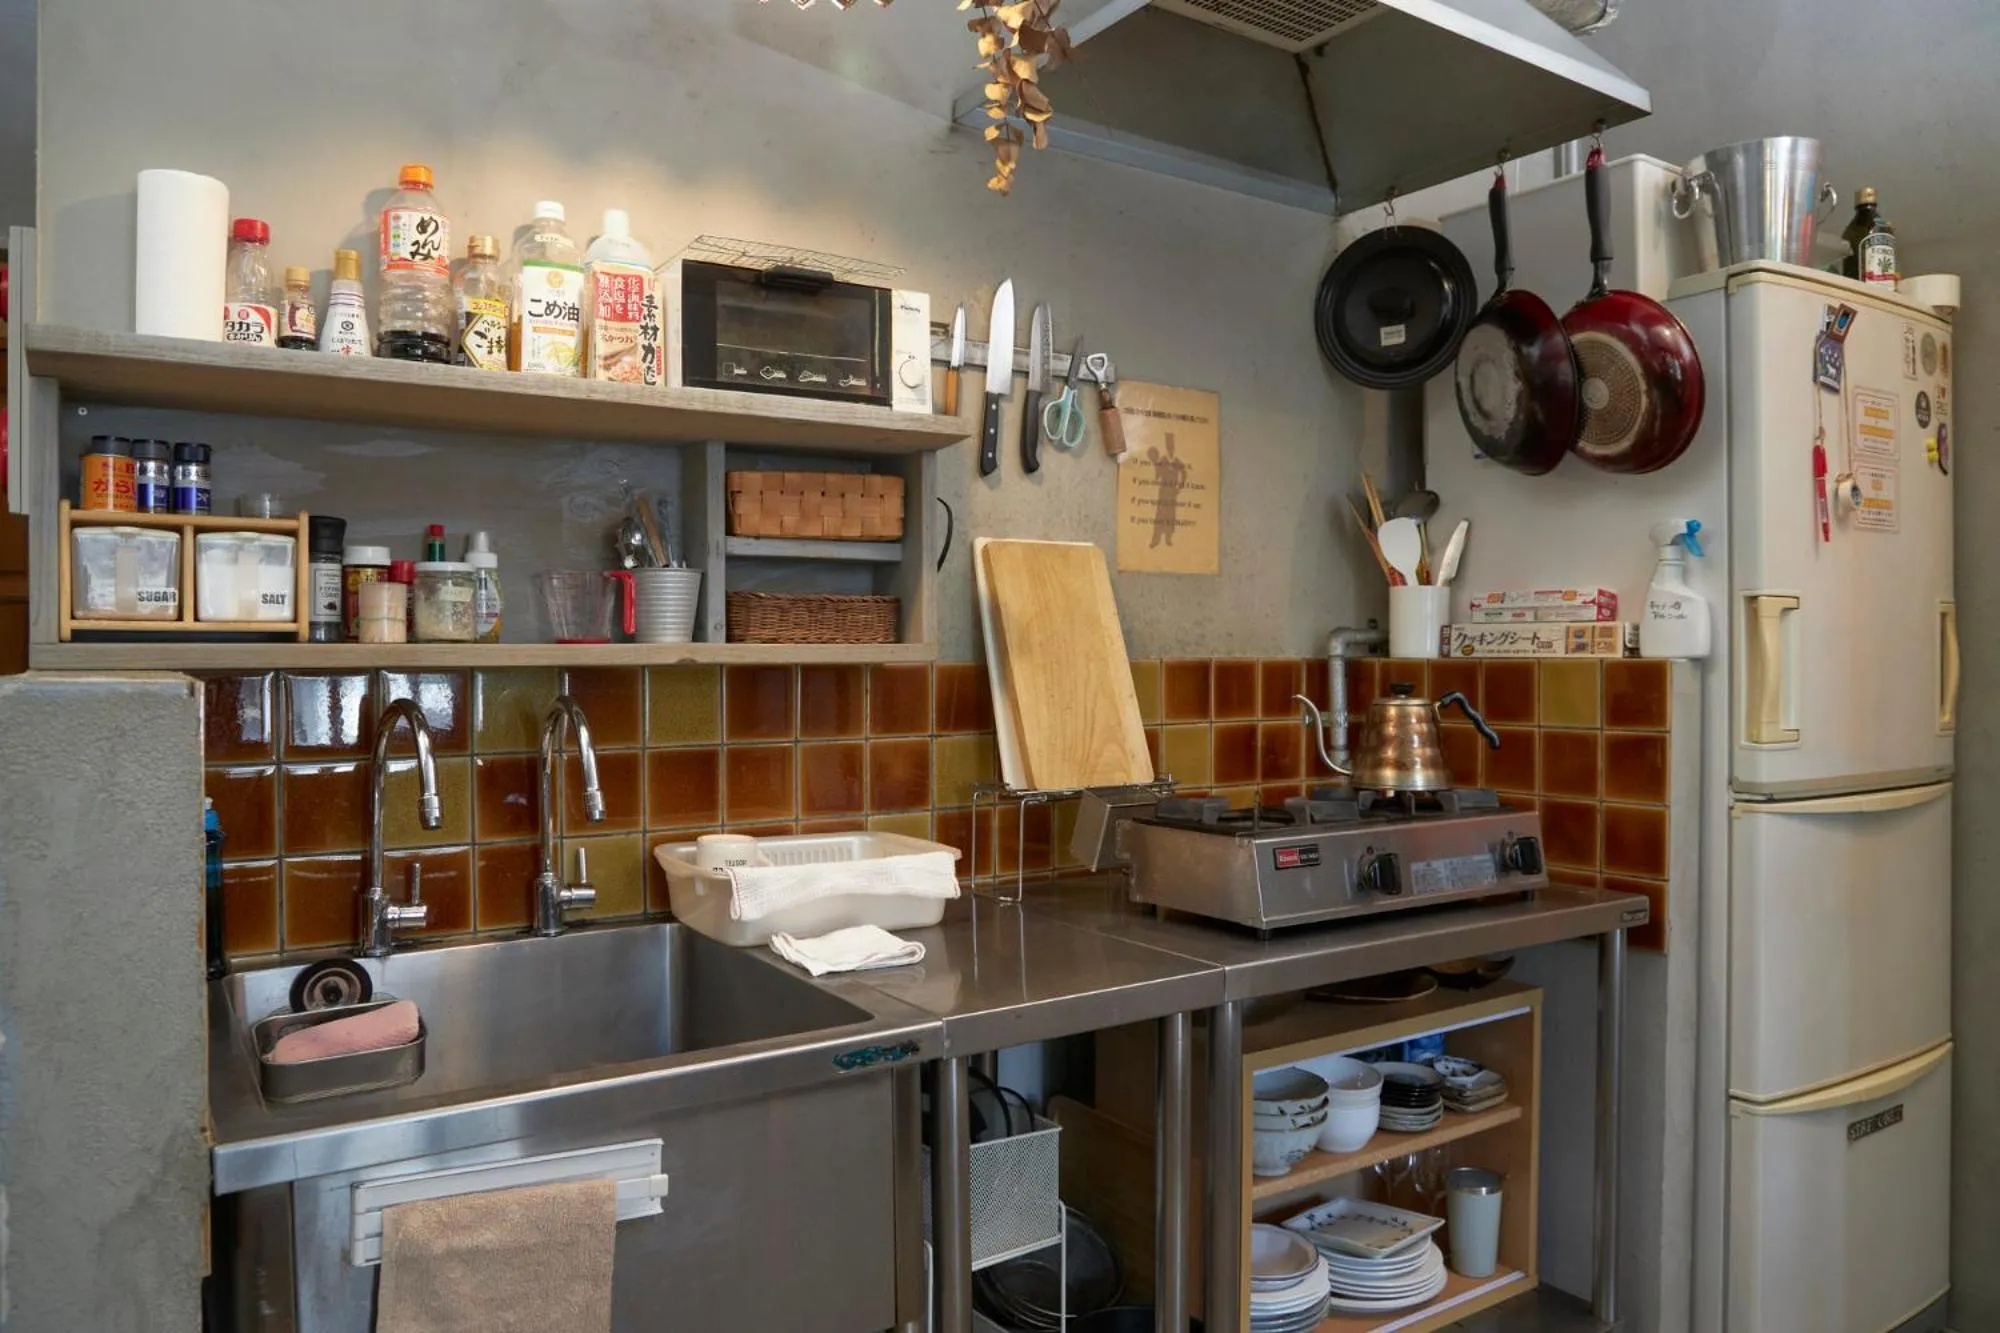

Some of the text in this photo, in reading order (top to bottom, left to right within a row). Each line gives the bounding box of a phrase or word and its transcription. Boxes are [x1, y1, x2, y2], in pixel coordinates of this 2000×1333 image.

[409, 215, 442, 261] めんみ
[527, 298, 580, 322] こめ油
[224, 320, 265, 335] タカラ
[137, 590, 177, 603] SUGAR
[261, 593, 288, 605] SALT
[1454, 631, 1541, 651] クッキングシート
